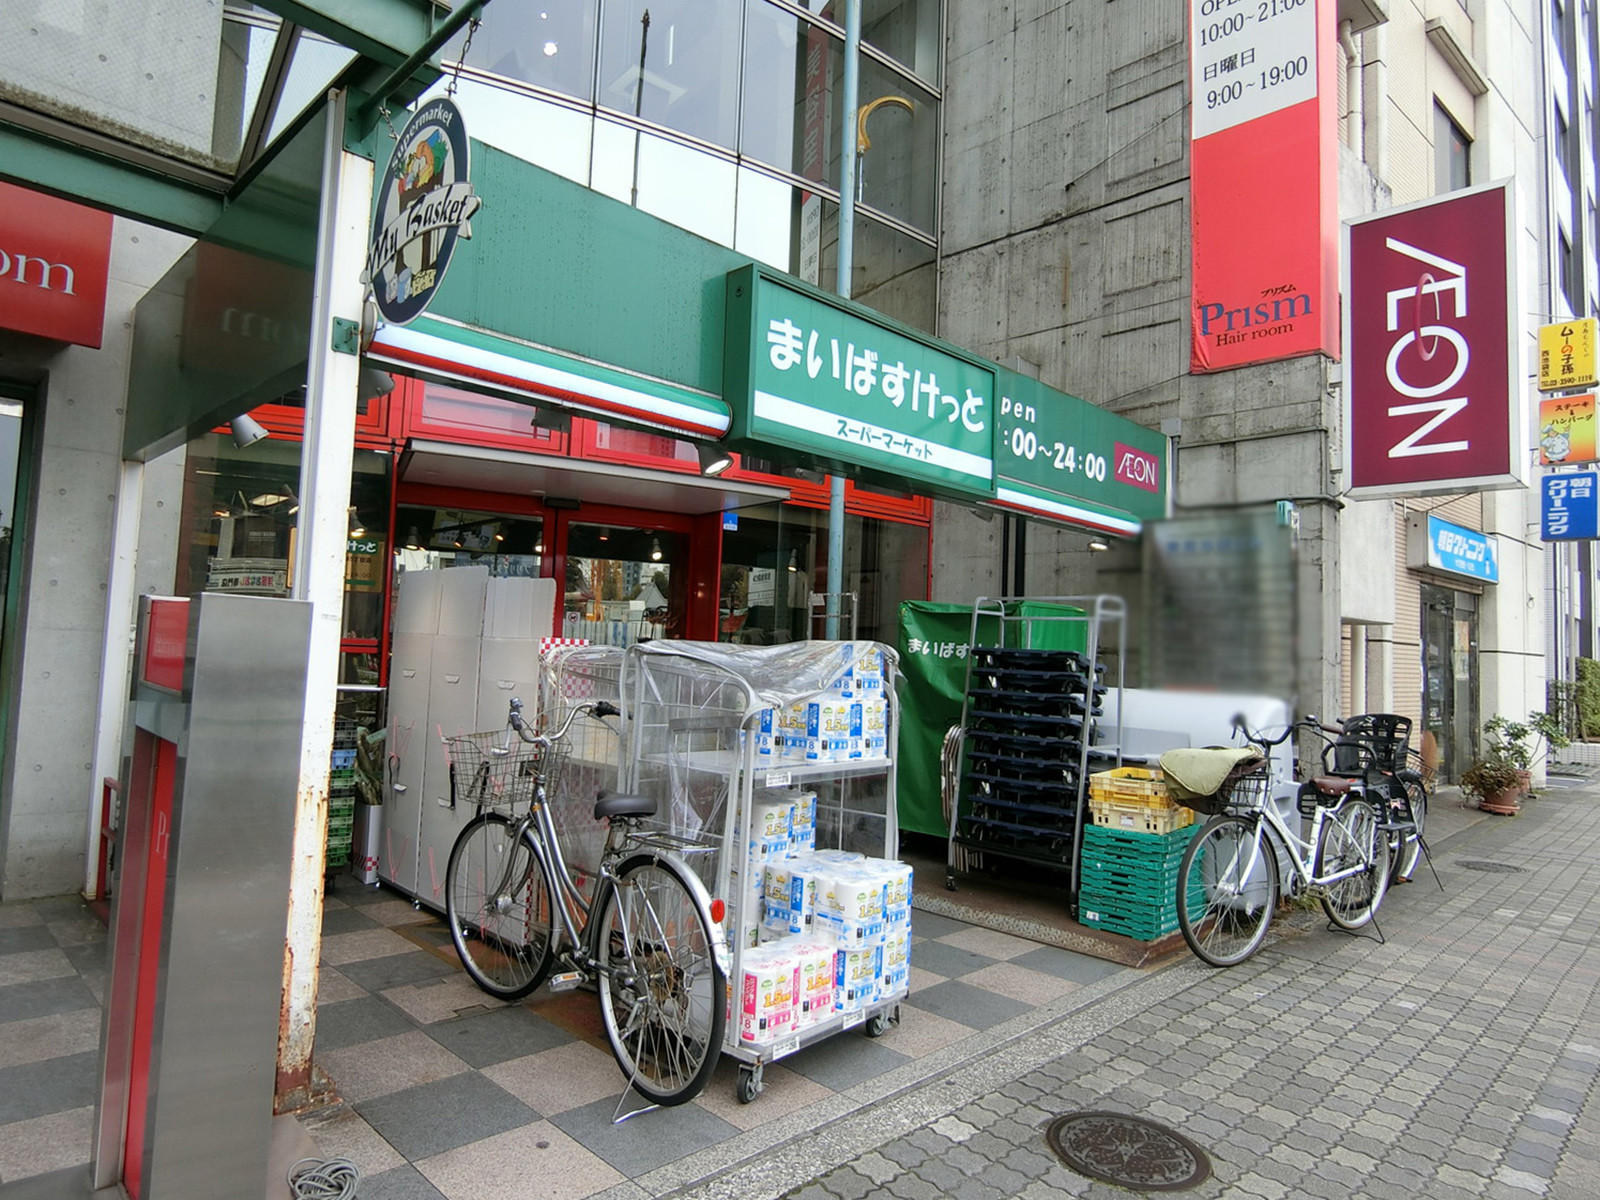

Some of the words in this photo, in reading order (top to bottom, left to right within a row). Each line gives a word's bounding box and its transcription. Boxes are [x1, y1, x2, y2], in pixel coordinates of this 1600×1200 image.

[1203, 47, 1255, 82] 日曜日
[367, 226, 399, 280] My
[407, 185, 468, 232] Basket
[1198, 294, 1314, 336] Prism
[1216, 330, 1249, 347] Hair
[1252, 323, 1293, 340] room
[1561, 326, 1574, 375] ムーの子孫
[767, 318, 985, 432] まいばすけっと
[1552, 413, 1593, 425] ハンバーグ
[1555, 401, 1589, 411] ステーキ
[837, 419, 932, 460] スーパーマーケット
[1548, 480, 1569, 535] クリーニング
[1570, 478, 1592, 498] 朝日
